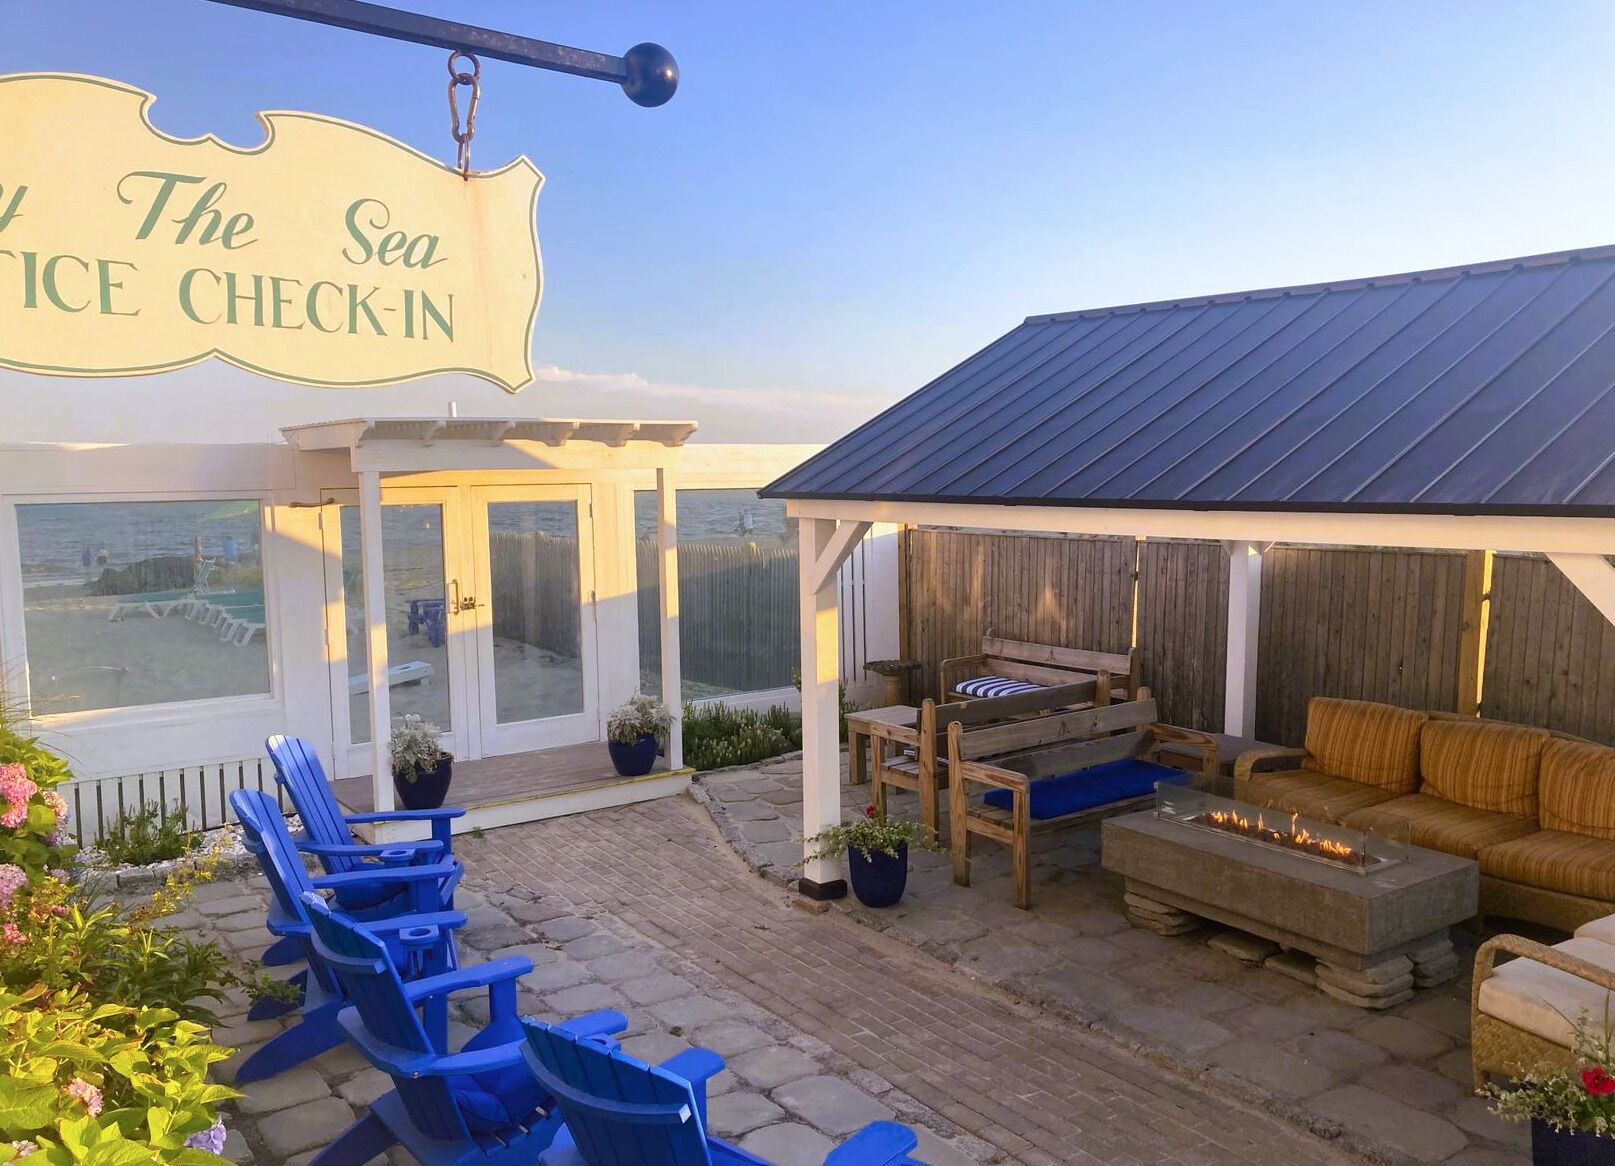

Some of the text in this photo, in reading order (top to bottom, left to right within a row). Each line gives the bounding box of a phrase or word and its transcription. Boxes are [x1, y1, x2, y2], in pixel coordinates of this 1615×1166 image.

[116, 170, 258, 250] The
[342, 198, 448, 269] Sea
[0, 249, 455, 343] ICE CHECK-IN
